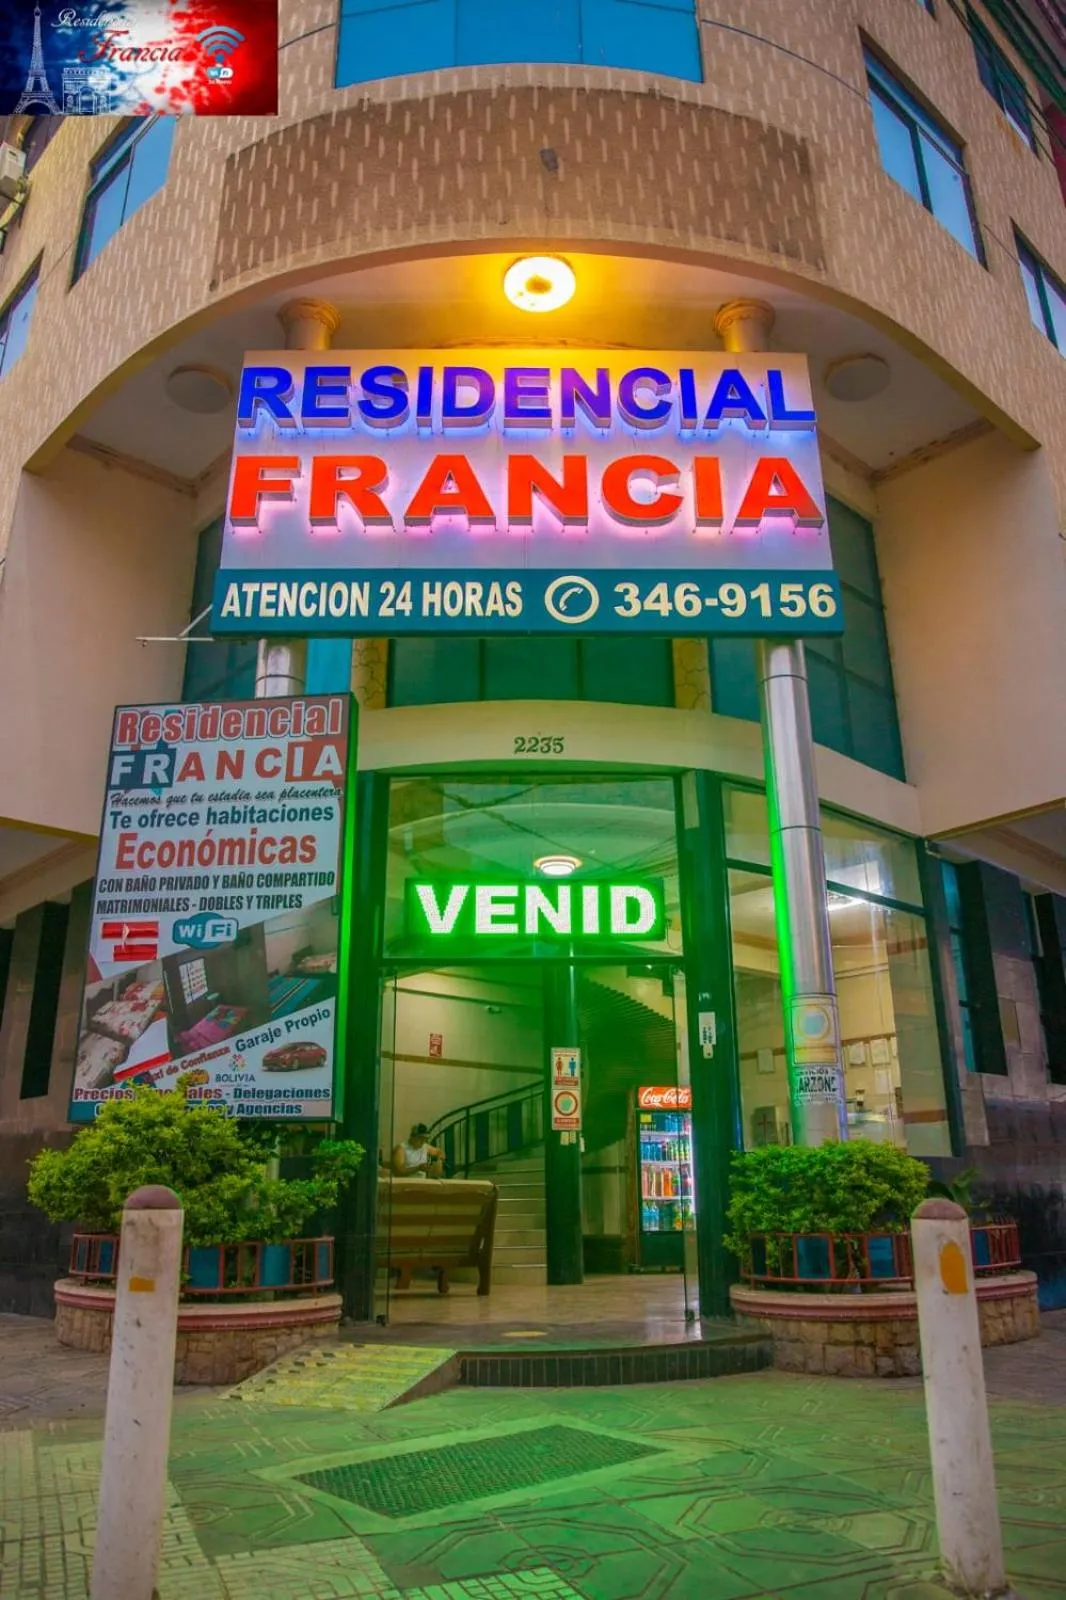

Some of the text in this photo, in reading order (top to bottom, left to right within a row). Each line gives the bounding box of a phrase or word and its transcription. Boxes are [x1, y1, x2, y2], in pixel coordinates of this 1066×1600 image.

[237, 365, 816, 430] RESIDENCIAL
[229, 454, 825, 528] FRANCIA
[221, 581, 523, 617] ATENCION 24 HORAS
[613, 582, 836, 617] 346-9156
[115, 700, 343, 746] Residencial
[514, 736, 564, 754] 2235
[110, 745, 344, 786] FRANCIA
[110, 793, 161, 808] Hacemos
[166, 793, 186, 809] que
[190, 791, 204, 803] tu
[255, 790, 274, 800] sea
[110, 804, 334, 829] Te ofrece habitaciones
[115, 827, 317, 870] Económicas
[99, 871, 335, 893] CON BAÑO PRIVADO Y BAÑO COMPARTIDO
[97, 897, 190, 915] MATRIMONIALES
[199, 896, 244, 911] DOBLES
[246, 895, 254, 909] Y
[256, 895, 303, 909] TRIPLES
[415, 884, 656, 935] VENID
[235, 1008, 331, 1052] Garaje Propio
[74, 1088, 134, 1101] Precios
[233, 1087, 331, 1100] Delegaciones
[215, 1073, 256, 1083] BOLIVIA
[236, 1103, 302, 1115] Agencias
